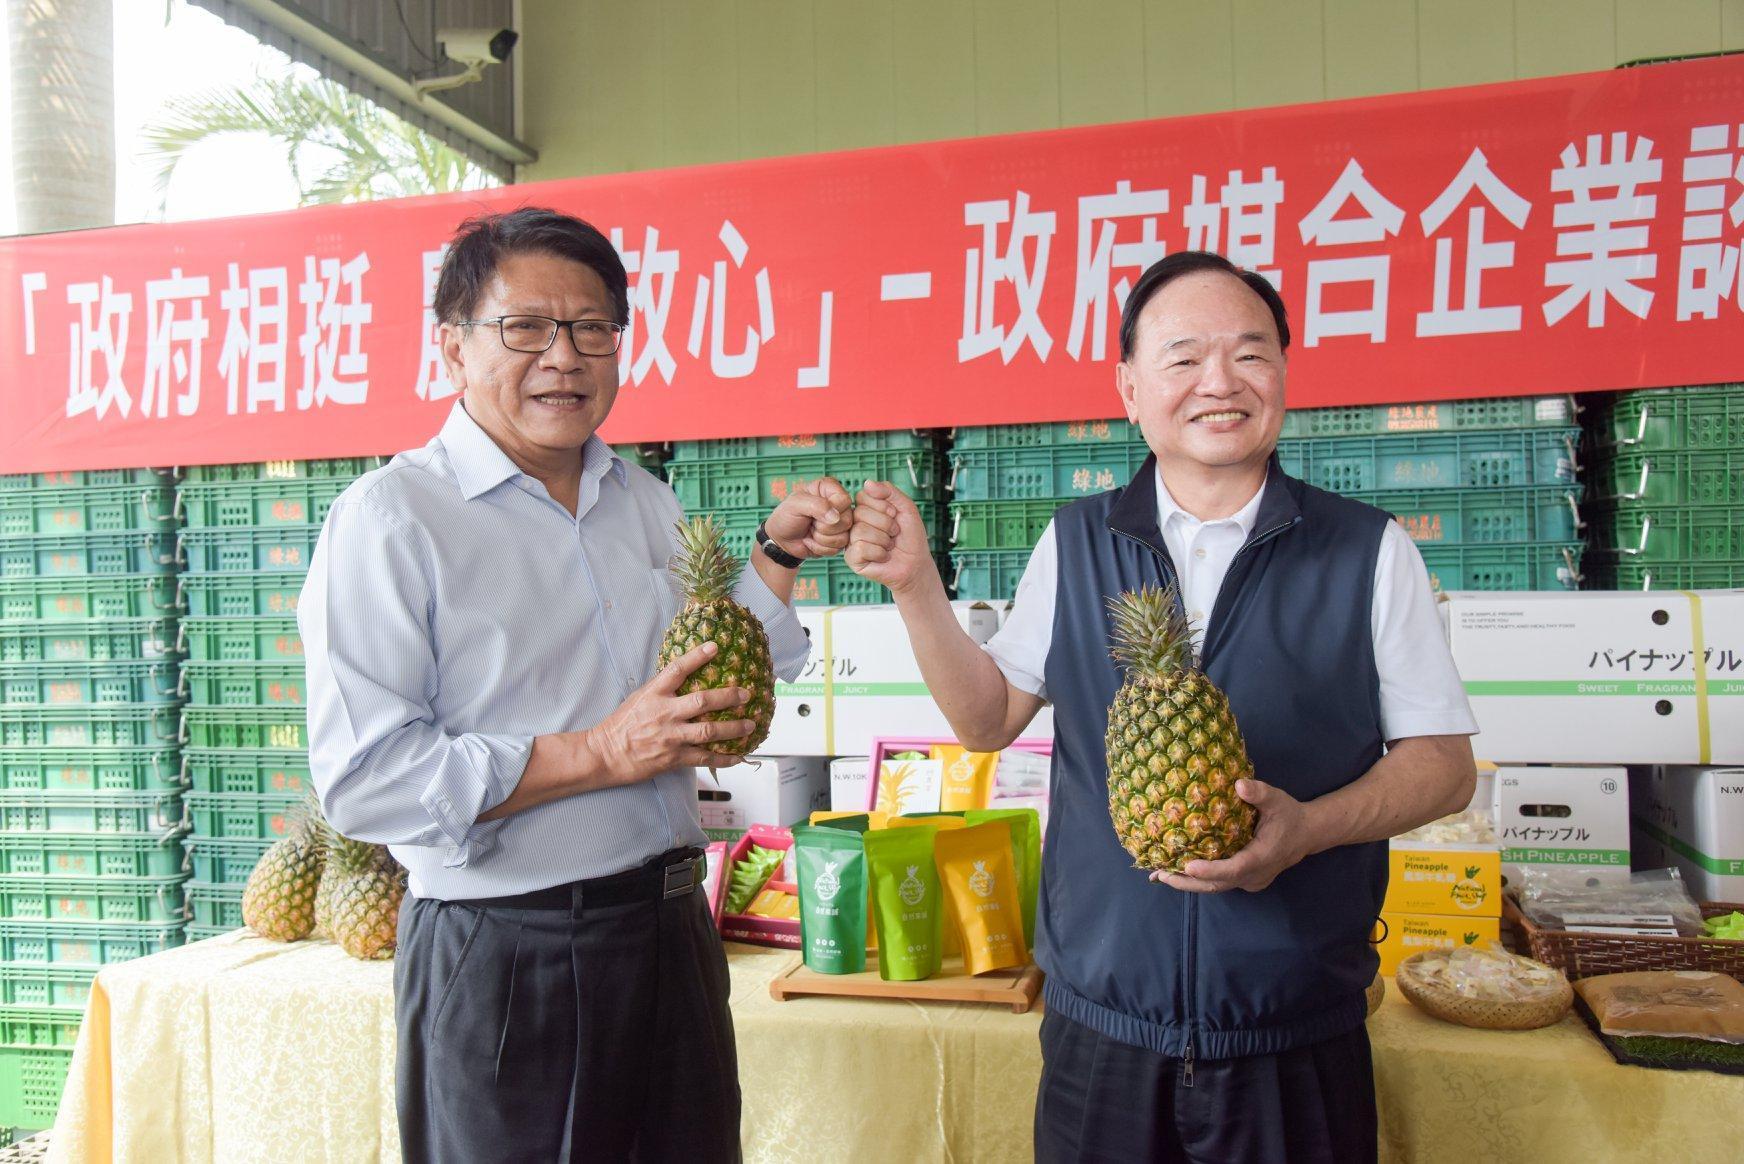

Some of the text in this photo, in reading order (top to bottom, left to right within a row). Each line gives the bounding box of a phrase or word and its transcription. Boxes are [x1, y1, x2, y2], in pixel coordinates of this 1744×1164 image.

[781, 686, 825, 694] FRAGRAN
[1577, 683, 1619, 693] SWEET
[1636, 683, 1697, 693] FRAGRAN
[833, 773, 868, 781] N.W.10K
[1502, 778, 1519, 786] GS
[1502, 850, 1620, 863] SH PINEAPPLE
[1404, 862, 1449, 871] Pineapple
[1403, 927, 1448, 936] Pineapple
